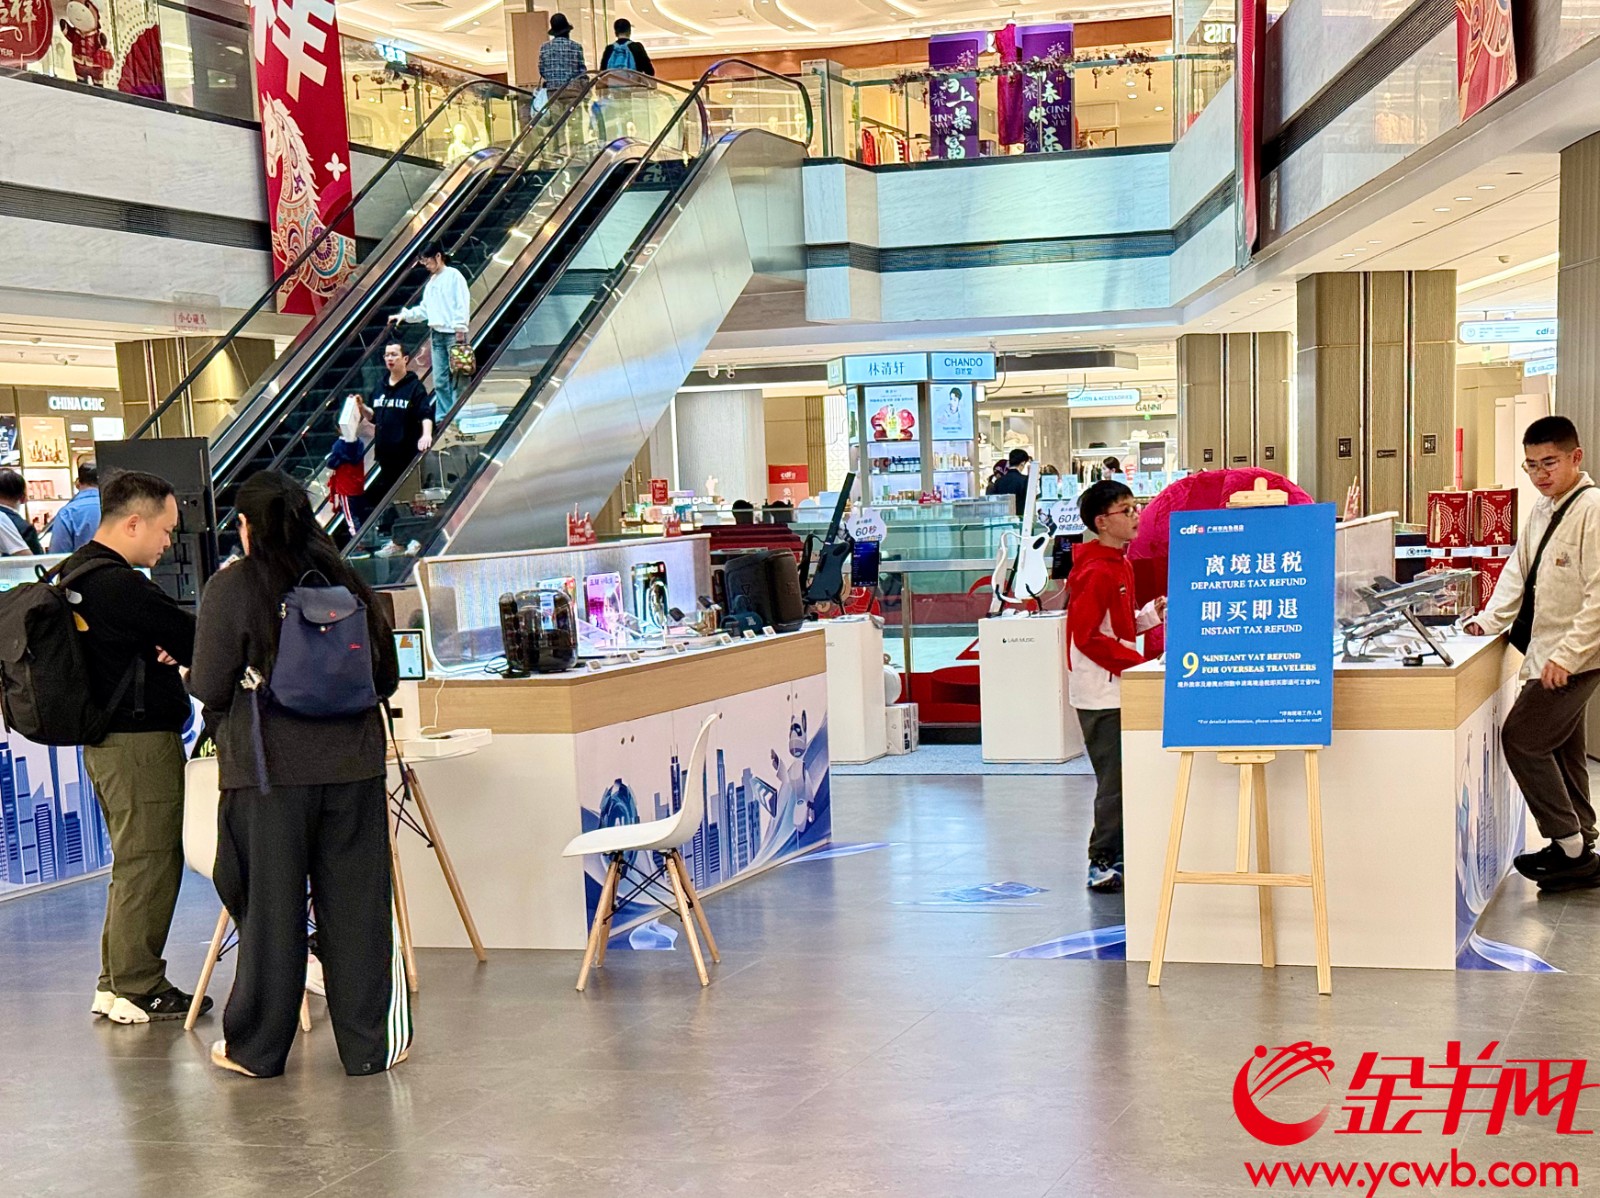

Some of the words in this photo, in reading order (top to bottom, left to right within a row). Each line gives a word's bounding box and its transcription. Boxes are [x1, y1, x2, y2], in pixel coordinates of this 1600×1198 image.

[868, 361, 905, 376] 林清轩
[944, 357, 983, 367] CHANDO
[49, 396, 81, 411] CHINA
[81, 397, 105, 412] CHIC
[1136, 404, 1161, 412] GANNI
[1180, 524, 1199, 534] cdf
[1205, 551, 1302, 576] 离境退税
[1191, 580, 1246, 591] DEPARTURE
[1247, 579, 1267, 588] TAX
[1269, 577, 1307, 587] REFUND
[1201, 598, 1298, 622] 即买即退
[1201, 626, 1241, 636] INSTANT
[1243, 625, 1263, 635] TAX
[1264, 624, 1303, 634] REFUND
[1182, 652, 1199, 679] 9
[1248, 653, 1265, 661] VAT
[1267, 652, 1301, 660] REFUND
[1202, 666, 1219, 674] FOR
[1221, 665, 1264, 673] OVERSEAS
[1266, 663, 1316, 672] TRAVELERS
